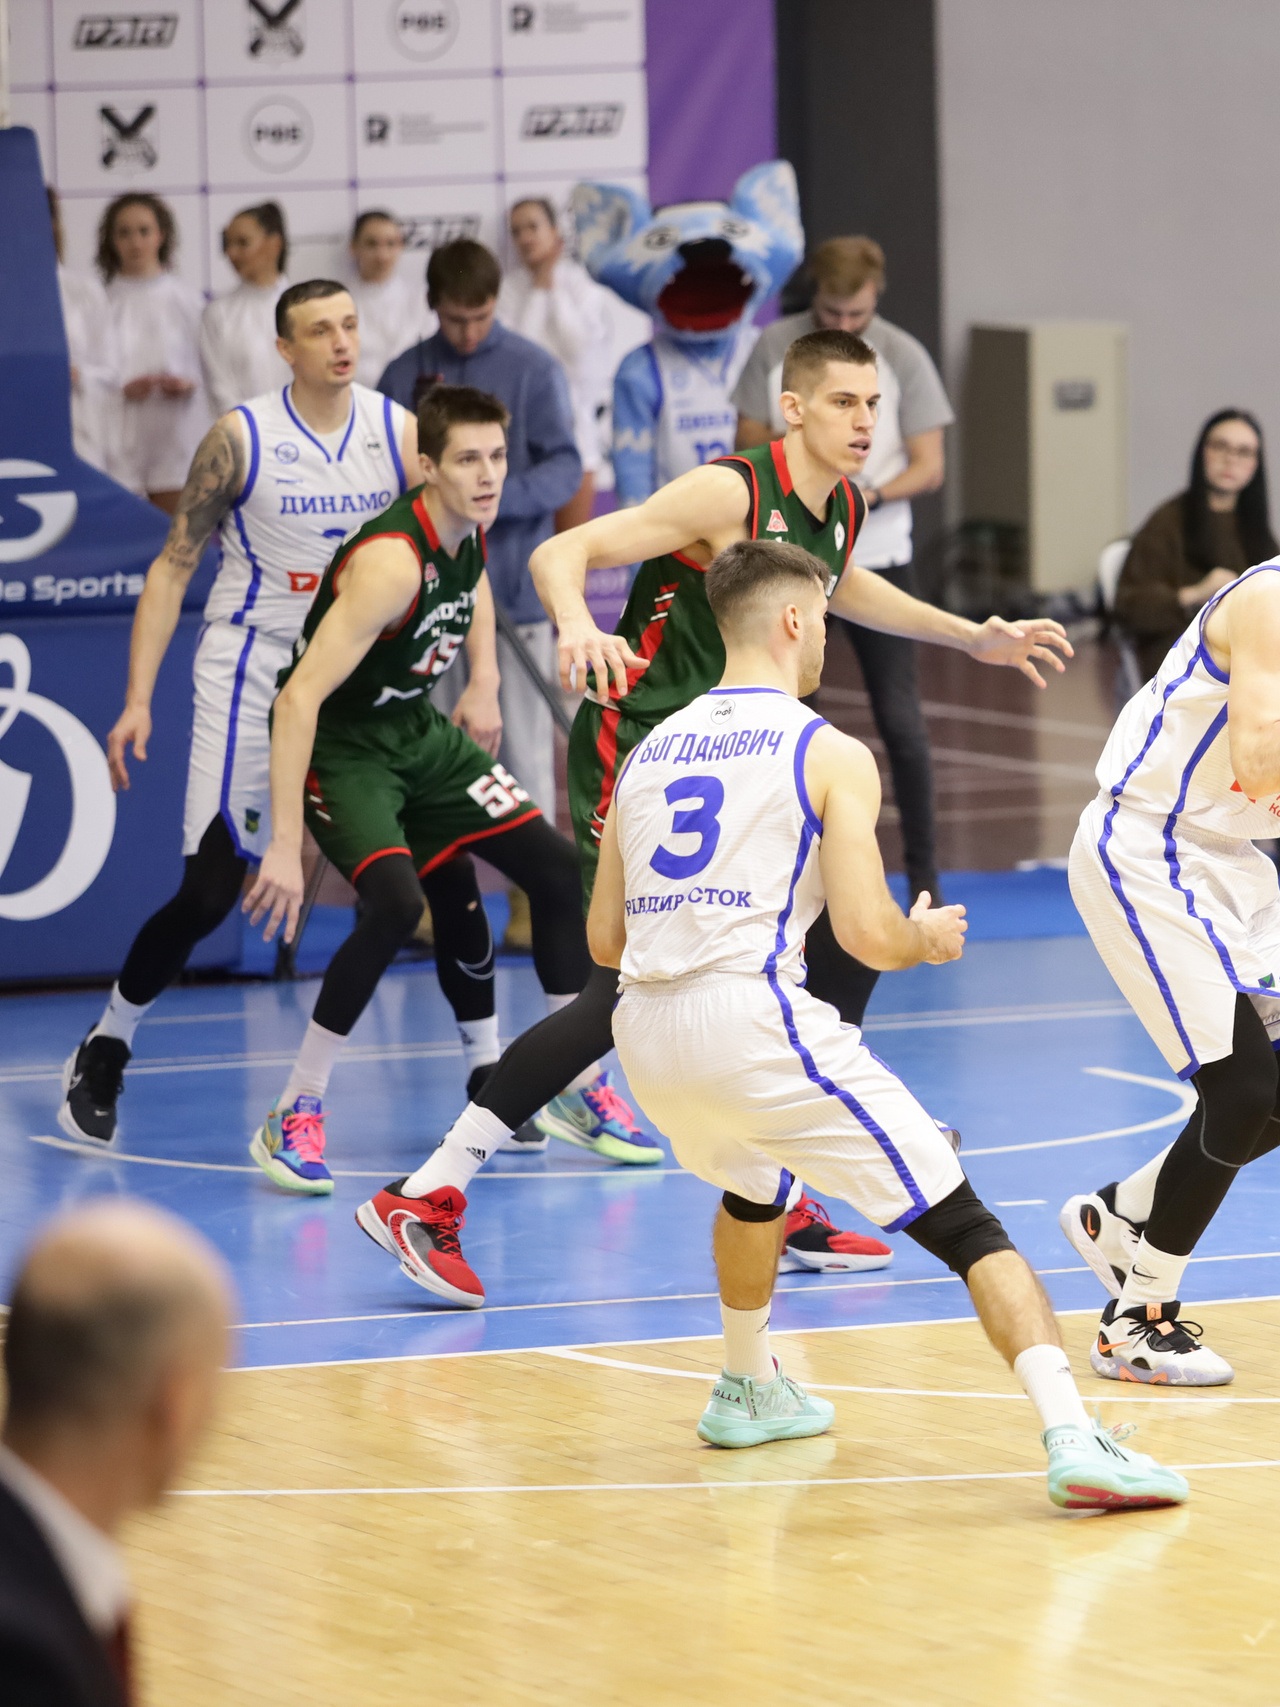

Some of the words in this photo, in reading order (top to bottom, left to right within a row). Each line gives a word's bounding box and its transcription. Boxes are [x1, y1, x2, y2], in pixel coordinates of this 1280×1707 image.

[280, 490, 392, 515] ДИНАМО
[32, 571, 147, 606] Sports
[639, 729, 784, 765] БОГДАНОВИЧ
[649, 775, 725, 880] 3
